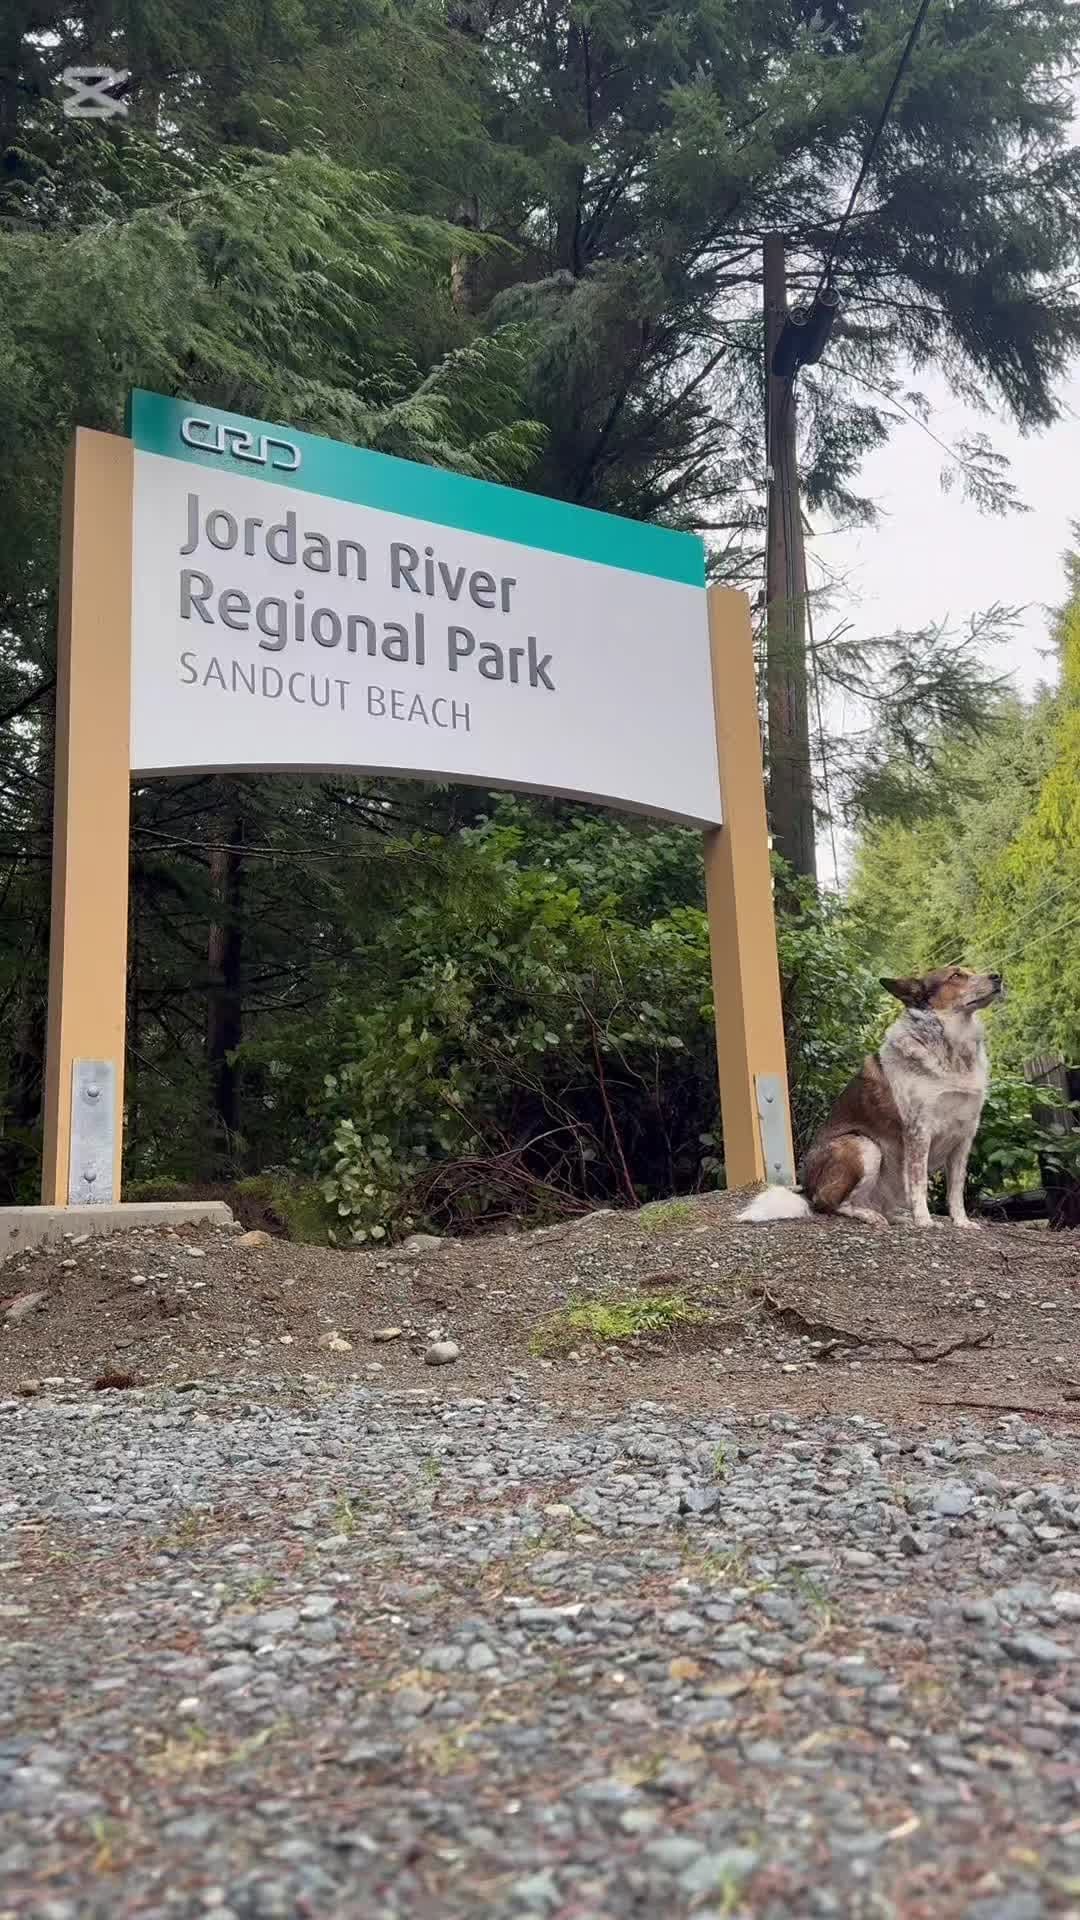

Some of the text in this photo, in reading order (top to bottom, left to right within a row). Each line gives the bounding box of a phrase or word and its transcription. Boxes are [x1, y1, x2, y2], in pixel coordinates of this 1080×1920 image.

[180, 493, 516, 613] Jordan River
[180, 568, 556, 690] Regional Park
[180, 651, 471, 732] SANDCUT BEACH
